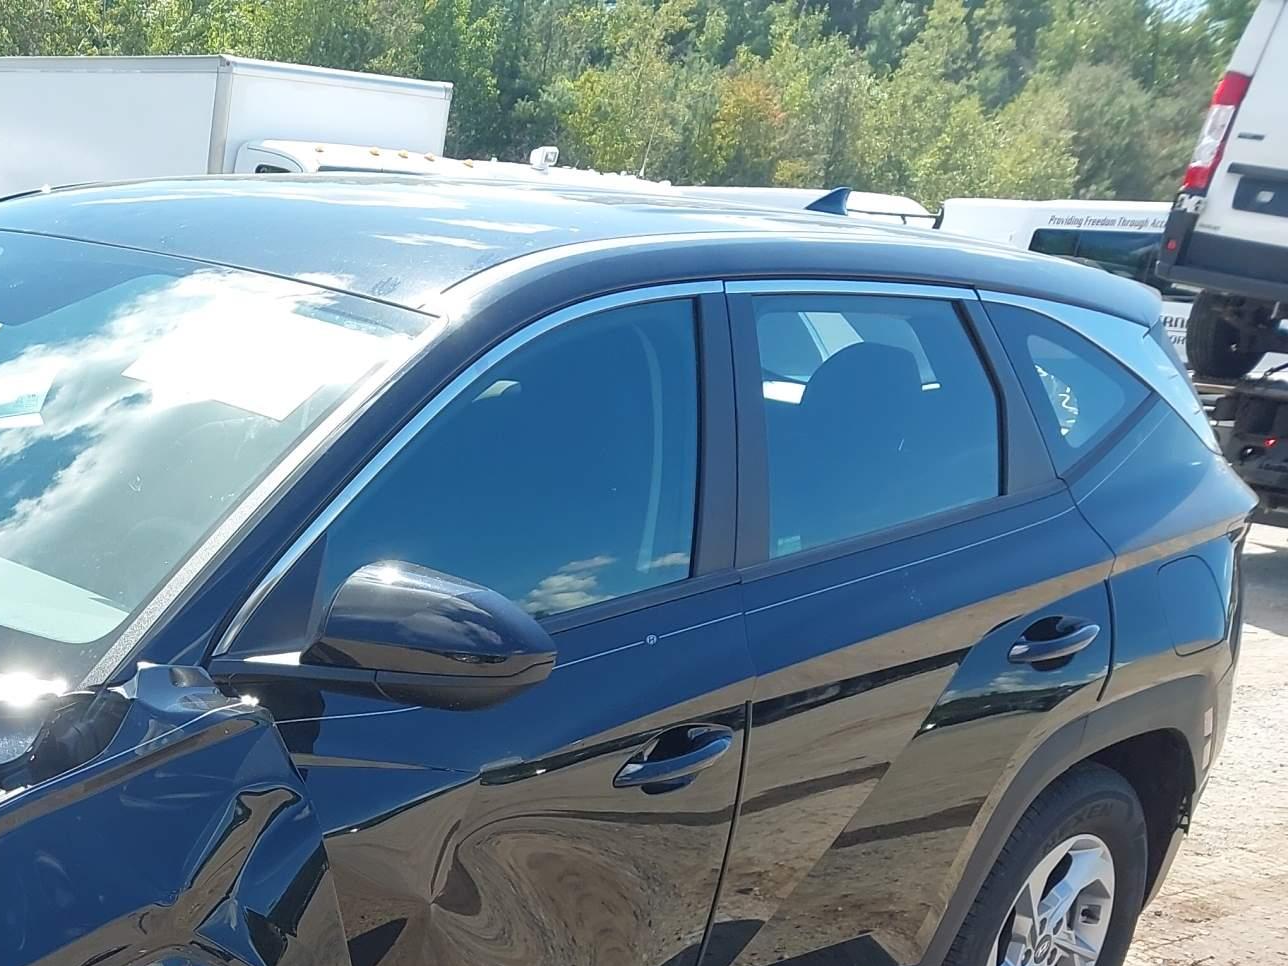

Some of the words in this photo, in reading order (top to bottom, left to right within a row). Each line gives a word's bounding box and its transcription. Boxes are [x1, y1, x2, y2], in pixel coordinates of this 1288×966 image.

[1048, 215, 1083, 228] Providing
[1084, 216, 1116, 226] Freedom
[1117, 216, 1149, 229] Through
